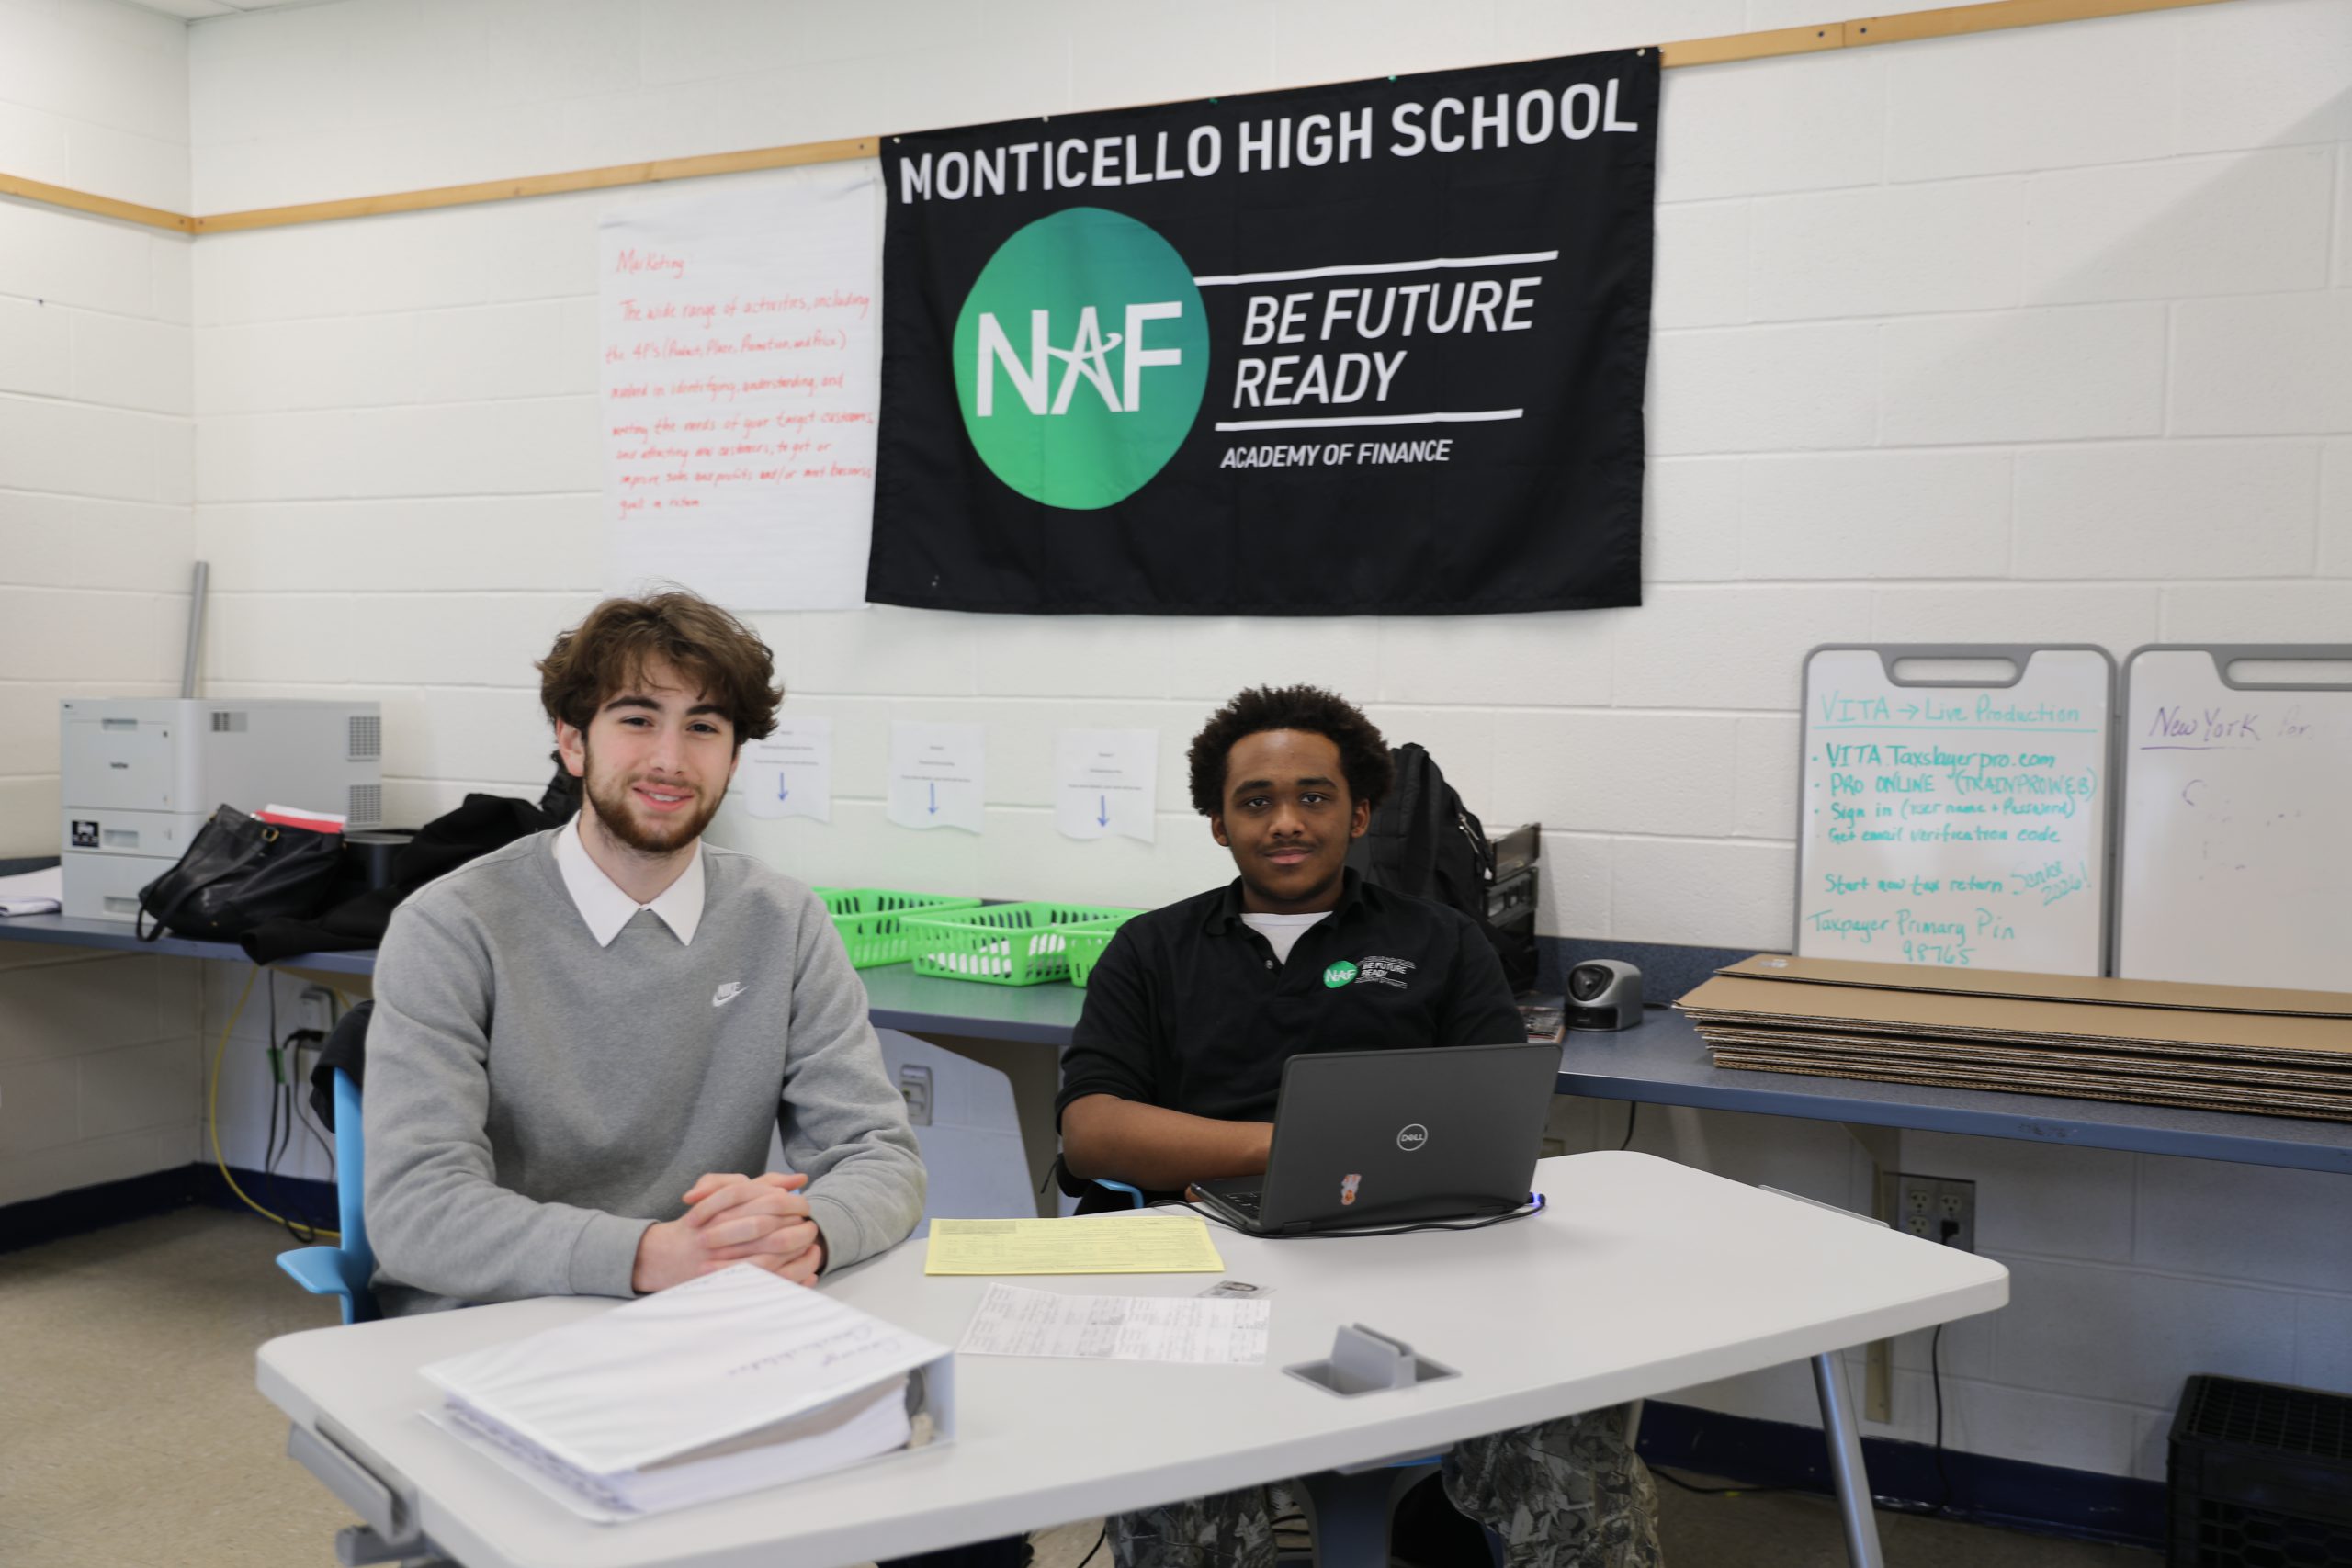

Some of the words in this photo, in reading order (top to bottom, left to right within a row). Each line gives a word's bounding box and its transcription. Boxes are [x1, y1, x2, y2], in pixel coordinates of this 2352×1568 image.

[900, 125, 1222, 204] MONTICELLO
[1239, 107, 1373, 173] HIGH
[1390, 78, 1638, 157] SCHOOL
[616, 248, 684, 279] Marketing
[619, 298, 641, 321] The
[647, 302, 676, 320] wide
[683, 304, 716, 330] range
[723, 294, 739, 316] of
[813, 288, 870, 320] including
[1241, 292, 1314, 346] BE
[1320, 276, 1542, 341] FUTURE
[605, 344, 625, 365] the
[977, 301, 1182, 417] NAF
[820, 368, 844, 389] and
[1233, 350, 1408, 409] READY
[654, 416, 676, 434] the
[723, 412, 741, 431] of
[743, 418, 769, 439] your
[776, 409, 816, 434] target
[817, 442, 832, 452] or
[1220, 444, 1321, 469] ACADEMY
[1323, 443, 1352, 467] OF
[1356, 439, 1453, 465] FINANCE
[1821, 690, 1890, 722] VITA
[1925, 697, 1968, 722] Live
[1976, 693, 2080, 723] Production
[2148, 706, 2198, 738] New
[2204, 707, 2262, 742] York
[1830, 773, 1864, 797] PRO
[1875, 774, 1935, 793] ONLINE
[1830, 802, 1866, 828] Sign
[1876, 802, 1892, 818] in
[1945, 804, 1986, 814] name
[1828, 828, 1857, 846] Get
[1861, 827, 1903, 842] email
[1910, 825, 2008, 846] verification
[2017, 825, 2061, 843] code
[1825, 874, 1869, 896] Start
[1911, 875, 1940, 896] tax
[1950, 875, 2003, 894] return
[1806, 908, 1890, 944] Taxpayer
[1896, 908, 1966, 948] Primary
[1975, 907, 2016, 940] Pin
[1902, 940, 1976, 964] 98765
[1326, 968, 1356, 982] NAF
[1375, 963, 1407, 975] FUTURE
[1401, 1134, 1424, 1142] DELL
